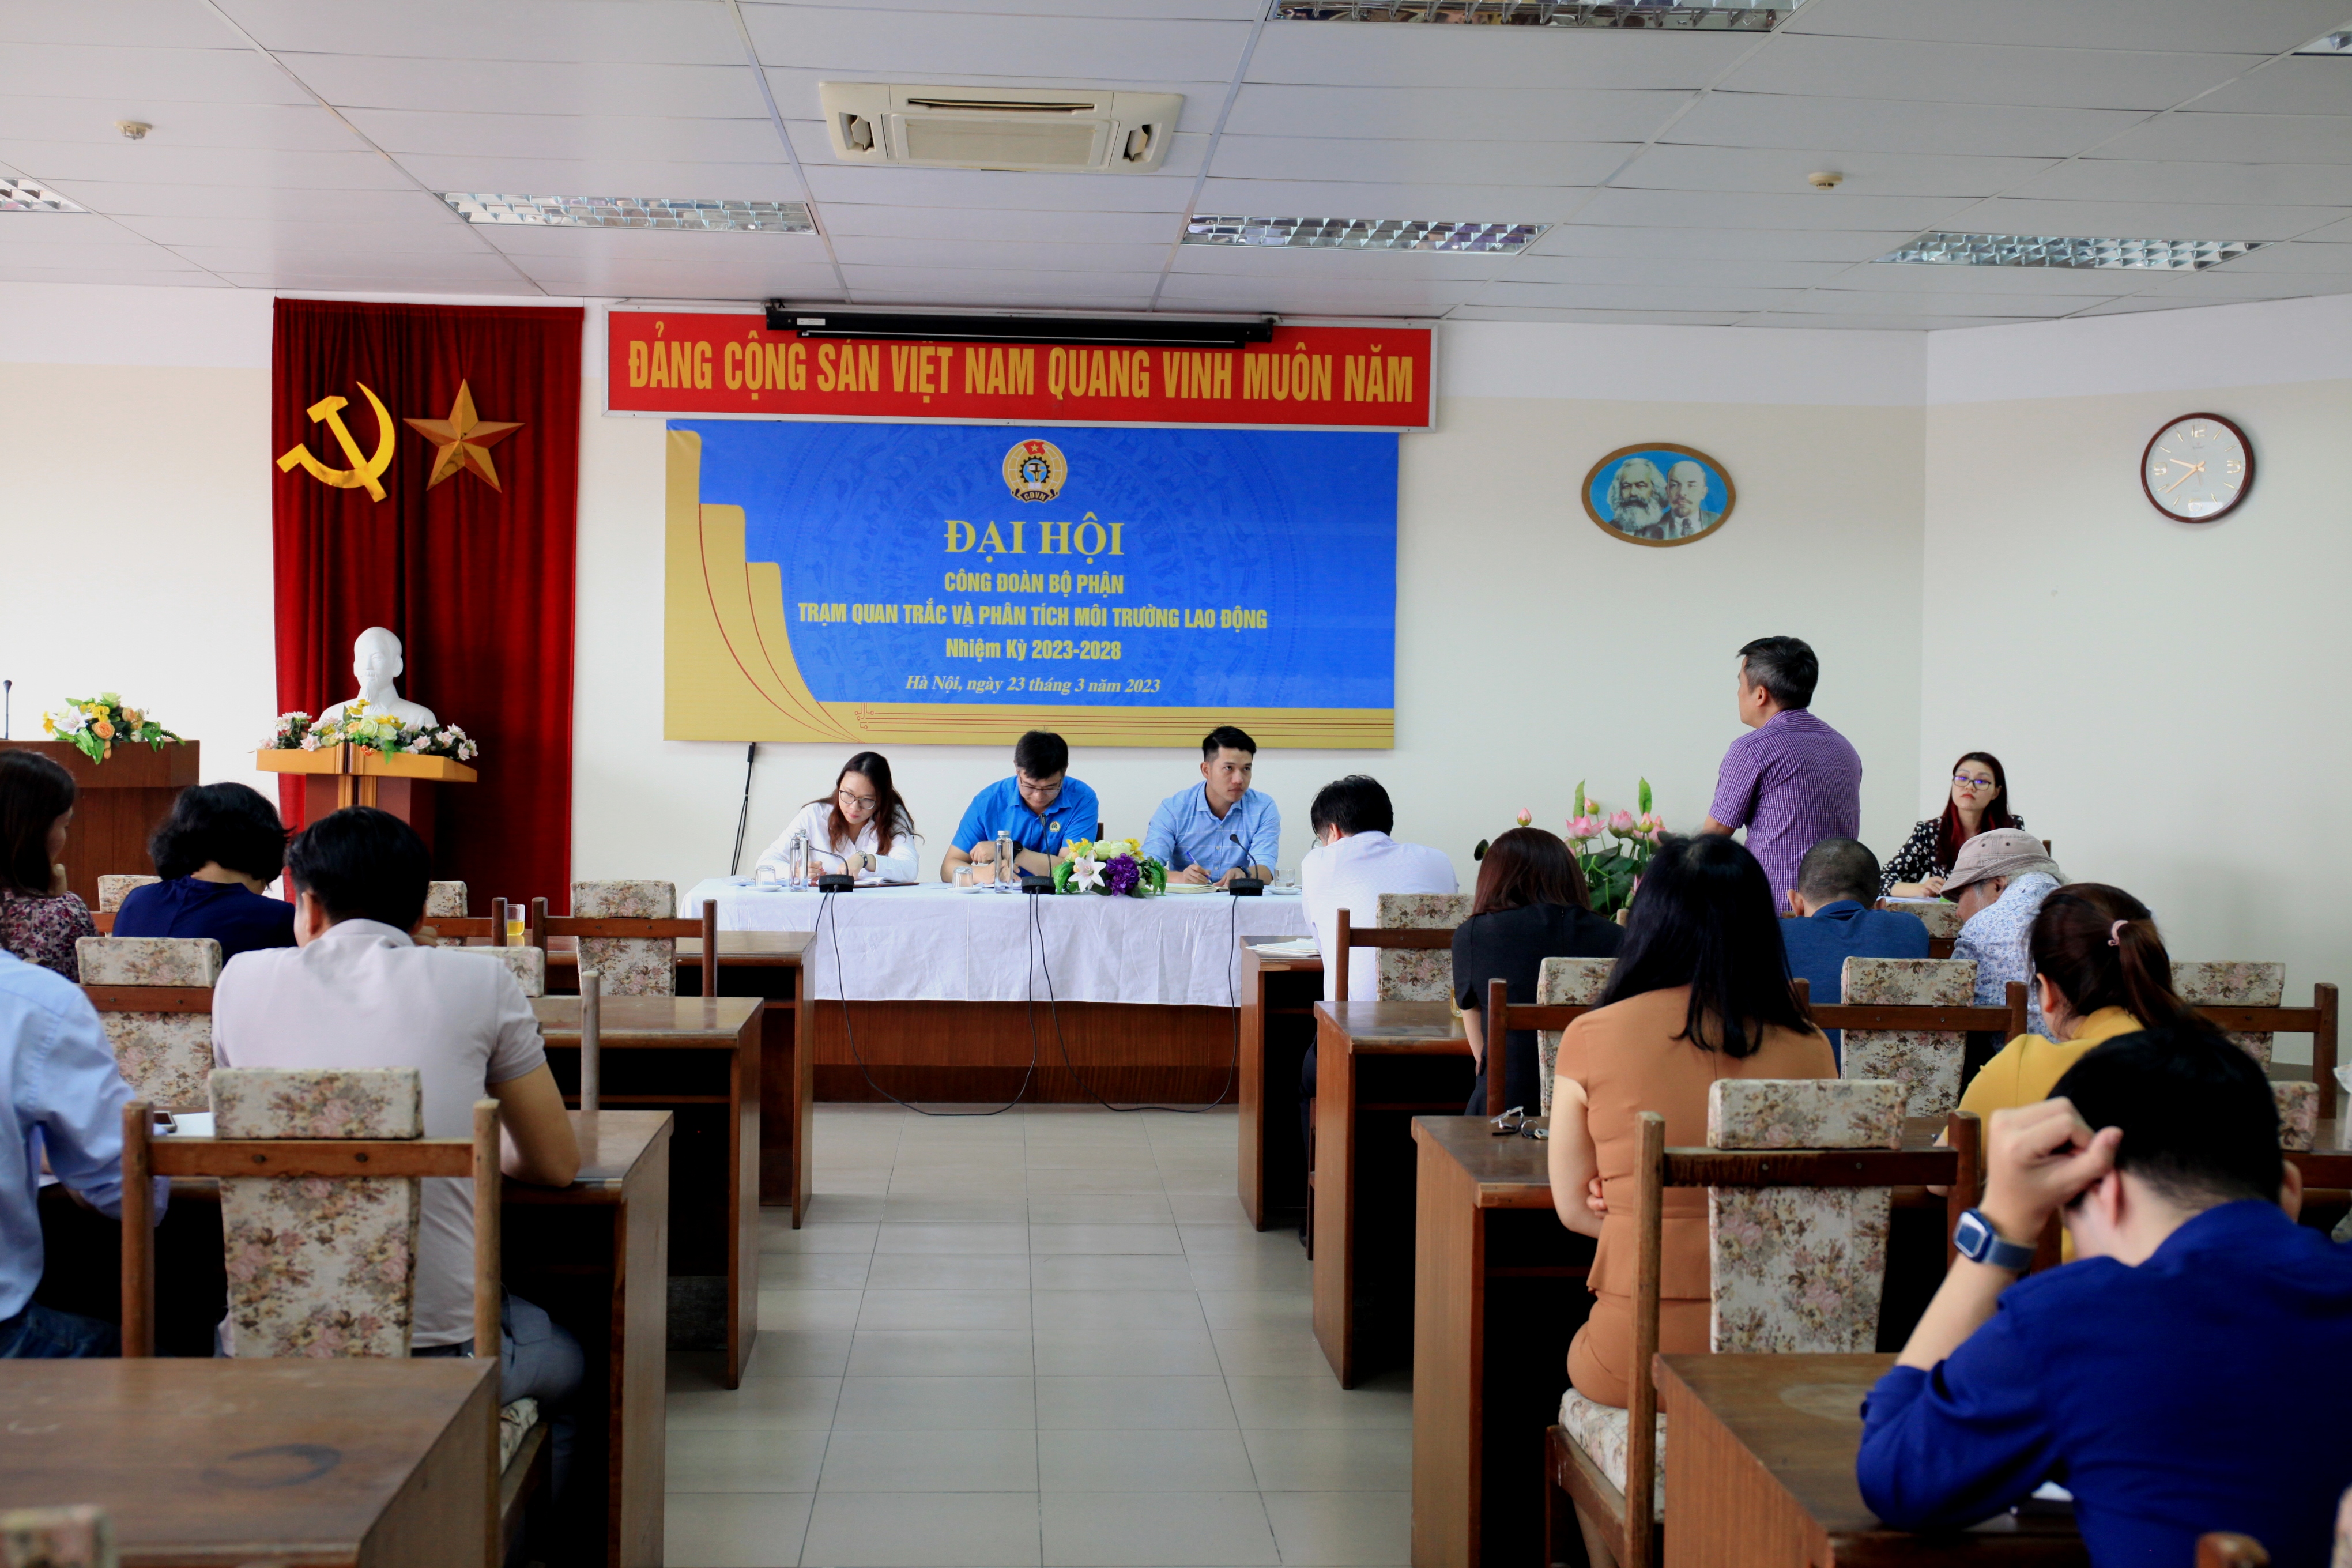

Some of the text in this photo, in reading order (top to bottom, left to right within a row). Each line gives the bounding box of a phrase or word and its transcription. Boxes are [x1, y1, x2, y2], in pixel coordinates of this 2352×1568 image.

[629, 321, 712, 389] ĐẢNG
[725, 331, 808, 400] CỘNG
[966, 348, 1034, 395] NAM
[1048, 347, 1149, 401] QUANG
[1163, 351, 1232, 399] VINH
[1243, 342, 1332, 401] MUÔN
[1344, 344, 1413, 402] NĂM
[2154, 460, 2241, 476] 9 3
[944, 511, 1124, 564] ĐẠI HỘI
[944, 568, 1124, 598] CÔNG ĐOÀN BỘ PHẬN
[798, 598, 1267, 632] TRẠM QUAN TRẮC VÀ PHÂN TÍCH MÔI TRƯỜNG LAO ĐỘNG
[946, 638, 1121, 662] Nhiệm Kỳ 2023-2028
[905, 675, 1160, 695] Hà Nội, ngày 23 tháng 3 năm 2023
